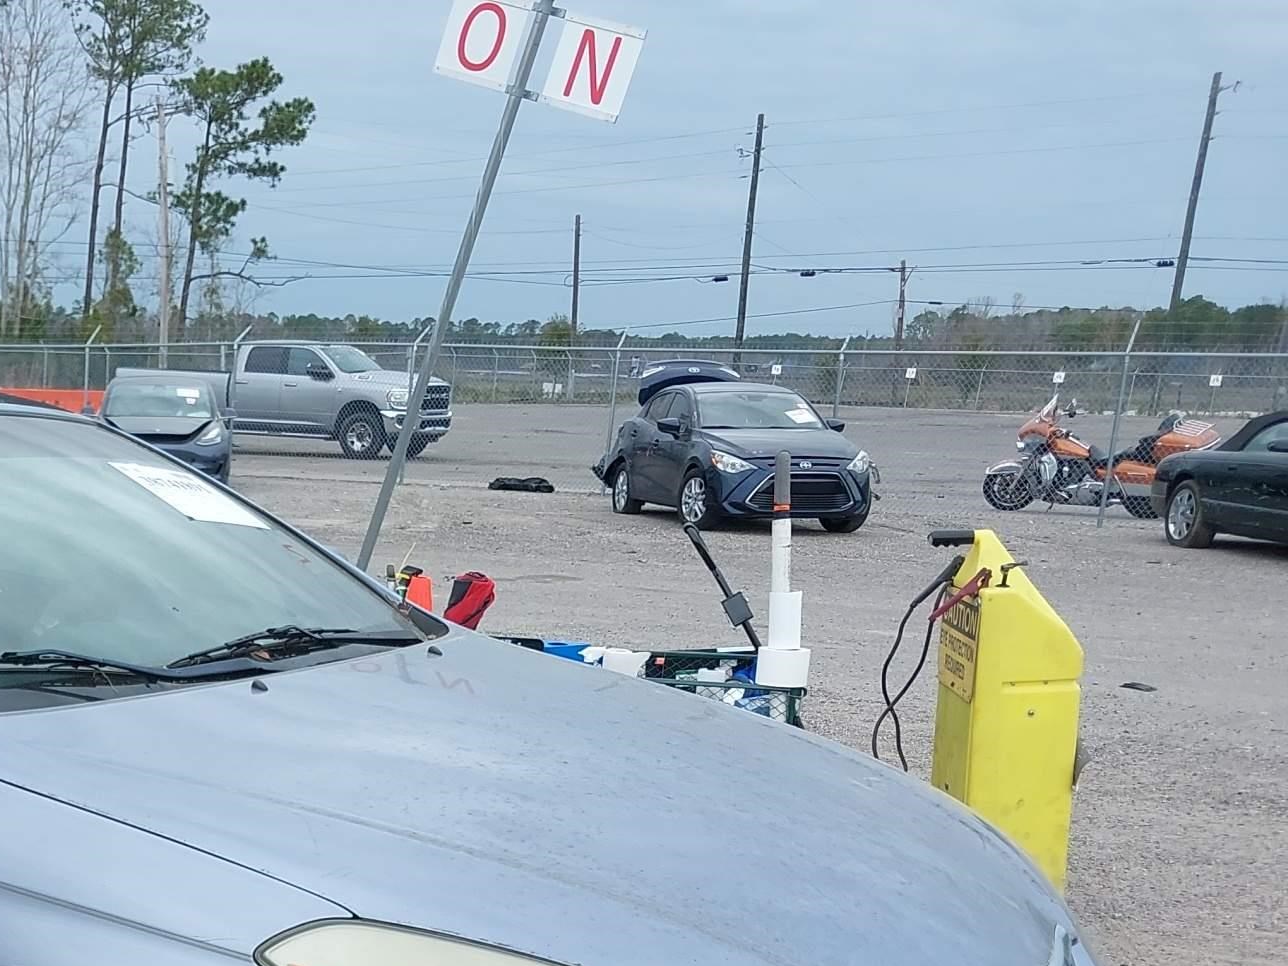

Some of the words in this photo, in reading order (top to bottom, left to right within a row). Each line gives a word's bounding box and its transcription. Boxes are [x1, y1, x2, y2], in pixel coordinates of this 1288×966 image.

[457, 1, 507, 72] O
[563, 28, 623, 105] N
[943, 597, 978, 636] CAUTION
[948, 633, 974, 664] PROTECTION
